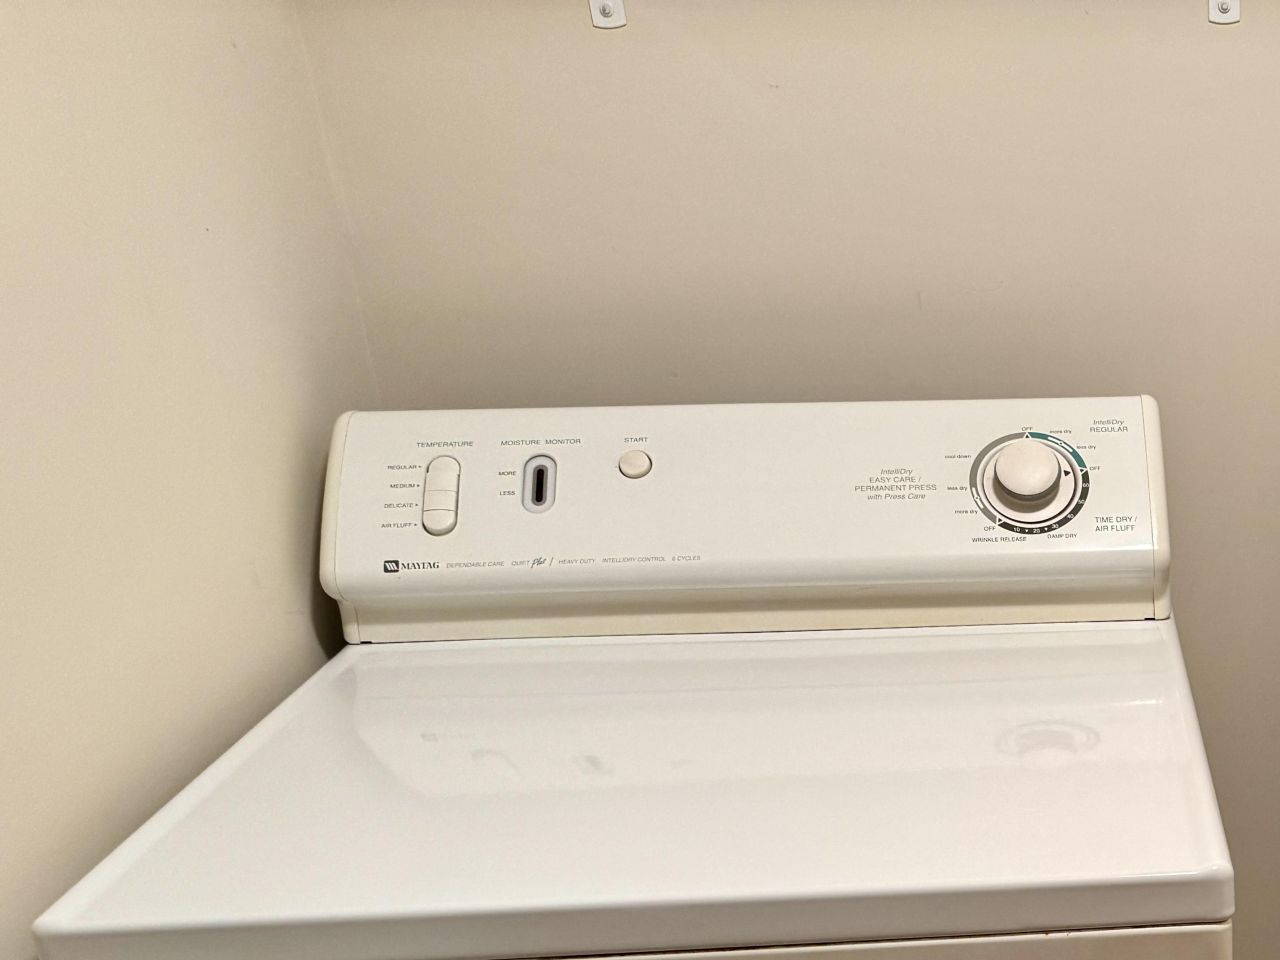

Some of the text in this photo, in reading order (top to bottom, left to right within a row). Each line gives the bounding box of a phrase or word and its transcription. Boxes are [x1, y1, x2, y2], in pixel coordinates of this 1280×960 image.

[880, 468, 913, 476] IntelliDry
[854, 484, 907, 492] PERMANENT
[401, 561, 440, 570] MAYTAG
